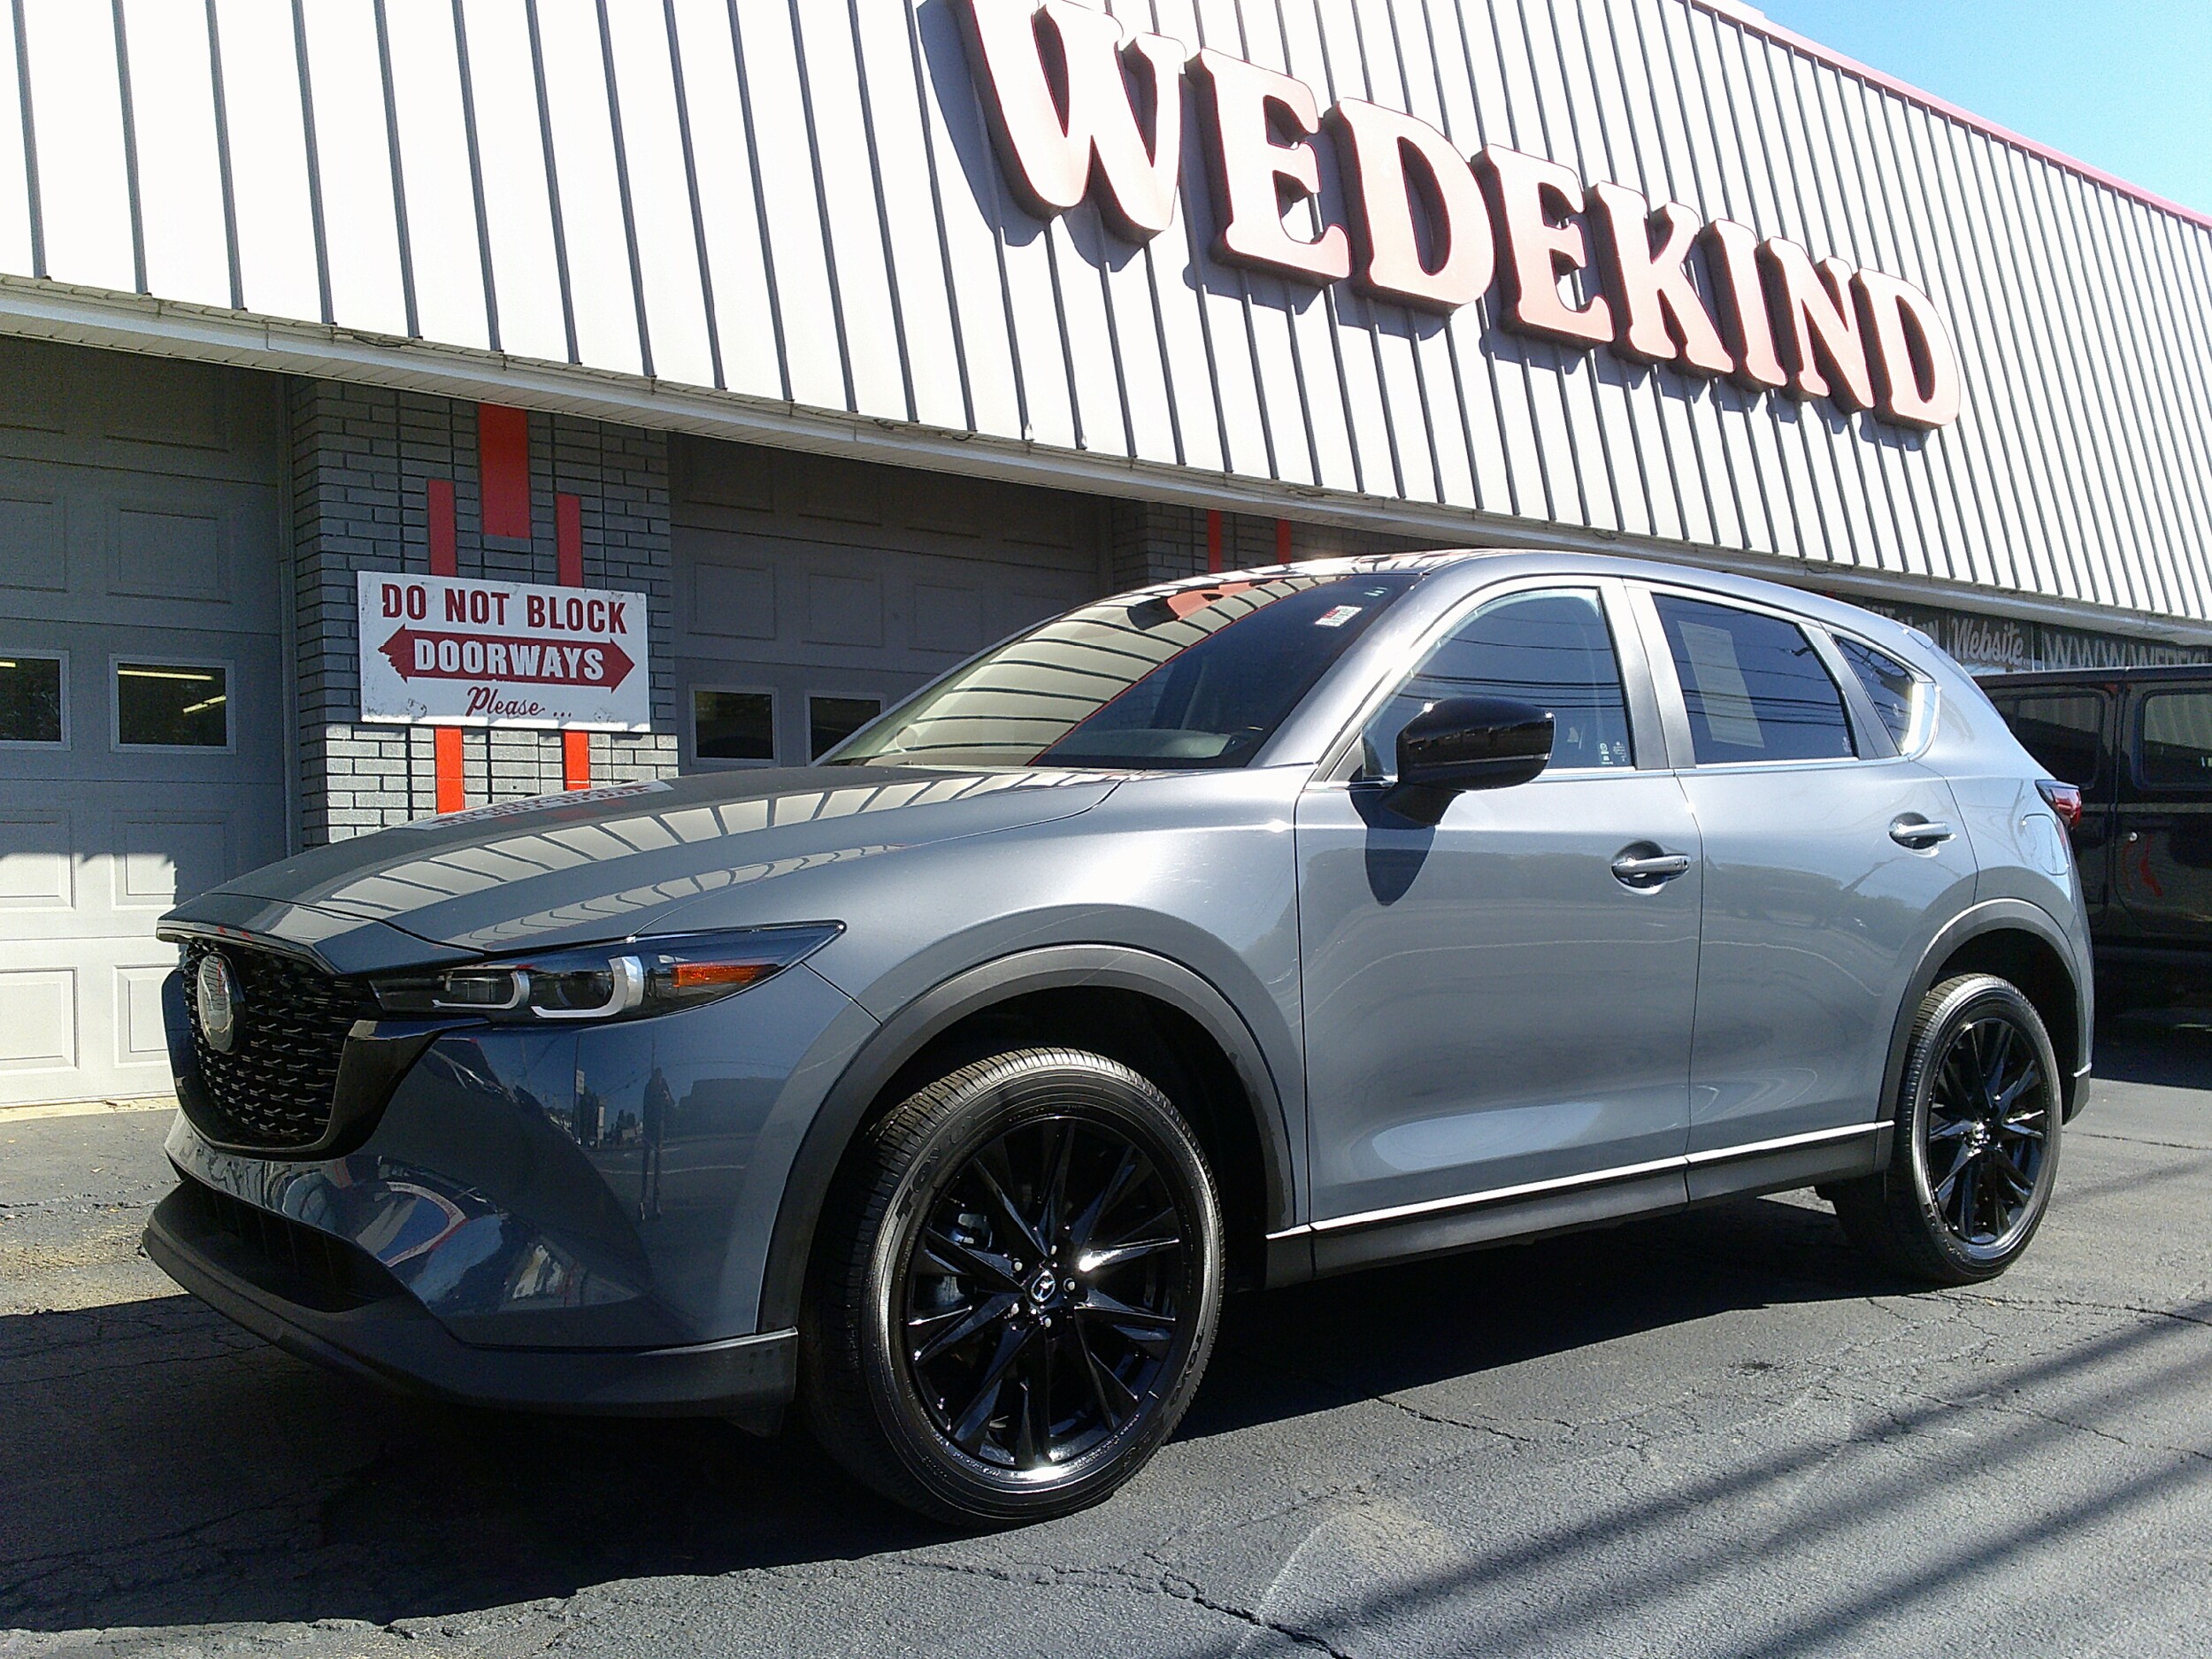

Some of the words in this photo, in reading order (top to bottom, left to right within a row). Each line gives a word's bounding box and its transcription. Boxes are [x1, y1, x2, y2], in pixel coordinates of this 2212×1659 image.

[969, 0, 1961, 426] WEDEKIND
[381, 583, 427, 620] DO
[444, 588, 511, 626] NOT
[526, 594, 628, 634] BLOCK
[414, 638, 605, 681] DOORWAYS
[465, 685, 546, 717] Please
